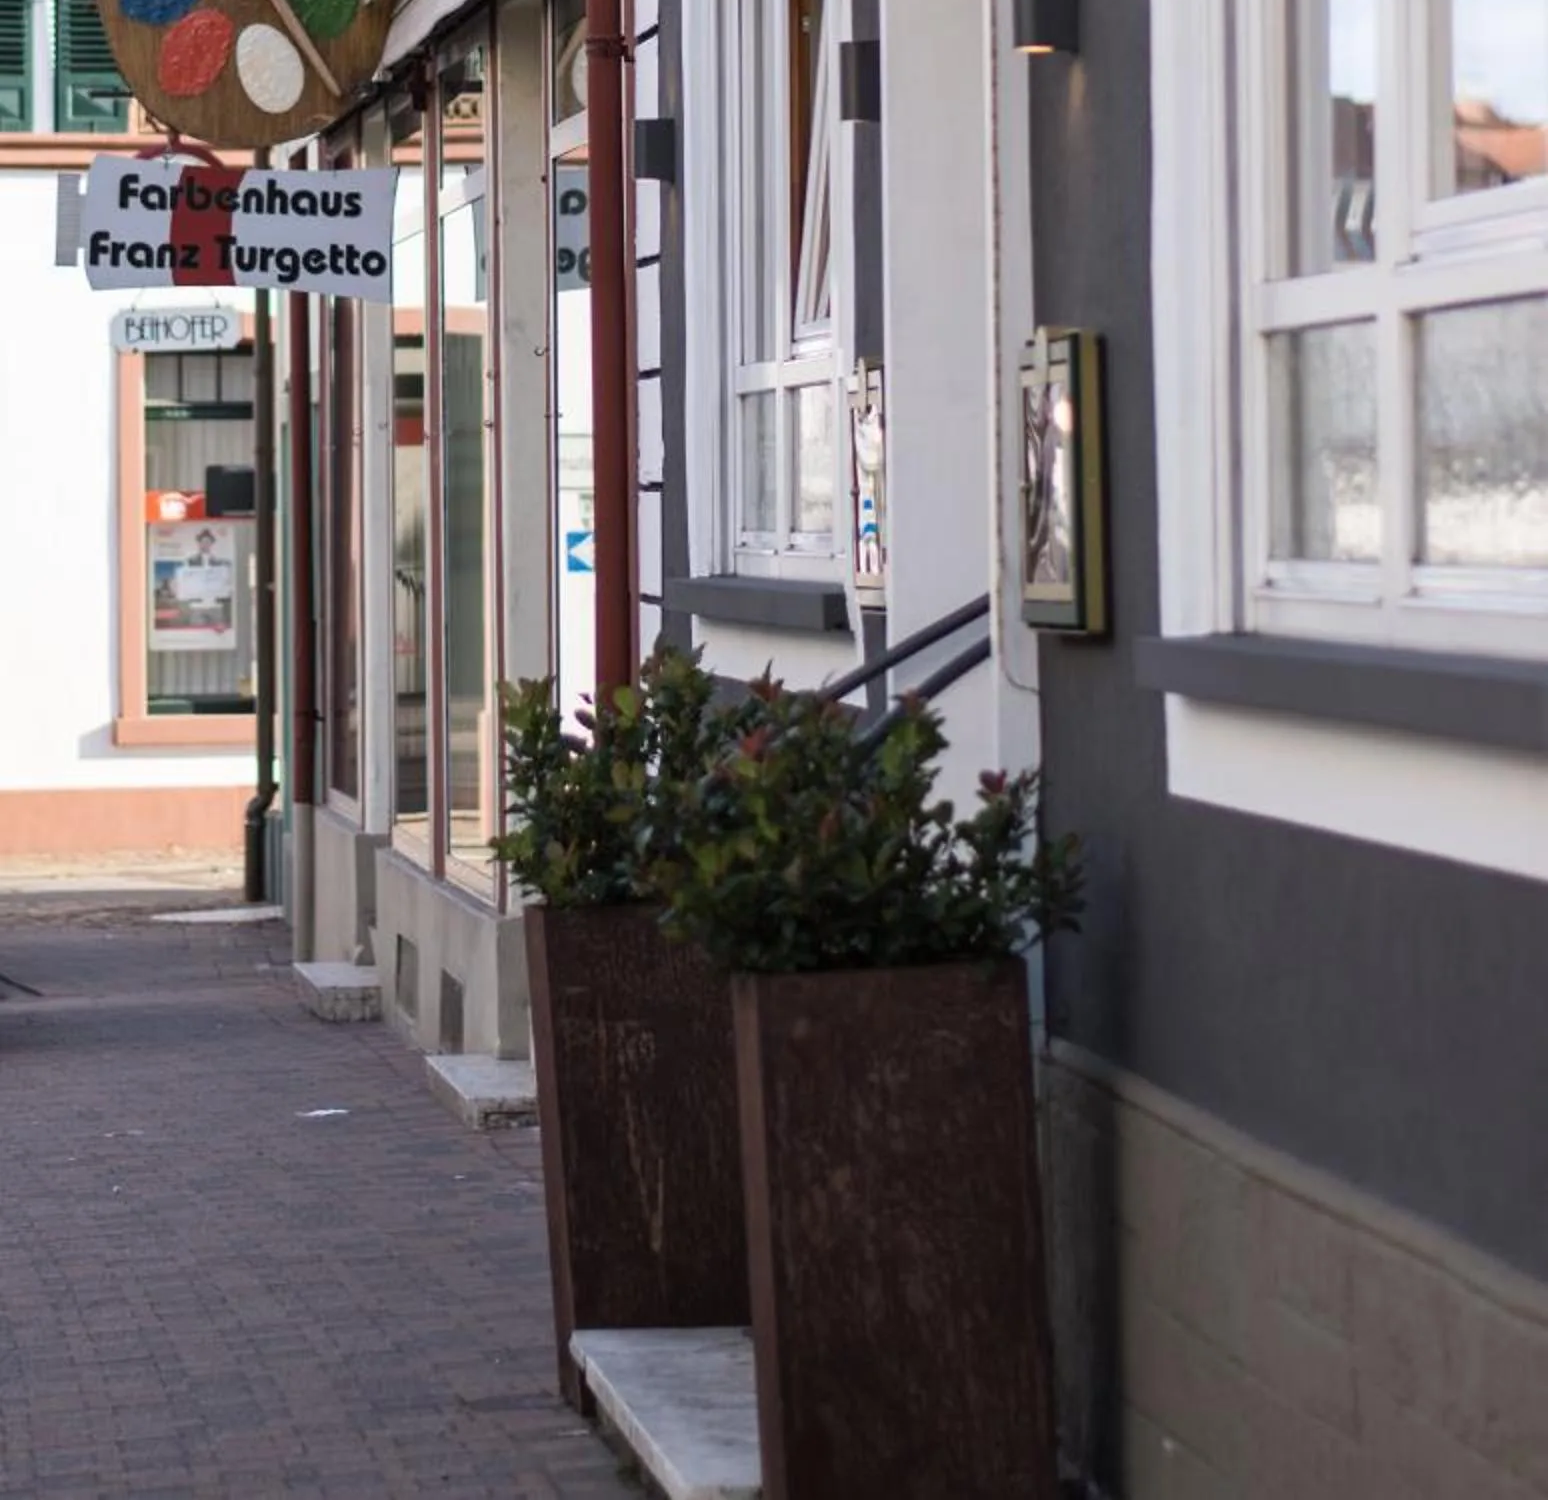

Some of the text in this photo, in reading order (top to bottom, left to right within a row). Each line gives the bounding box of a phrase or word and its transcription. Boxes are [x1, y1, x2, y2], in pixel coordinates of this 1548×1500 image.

[118, 173, 363, 218] Farbenhaus
[89, 230, 387, 283] Franz Turgetto
[125, 314, 228, 344] BEIHOFER
